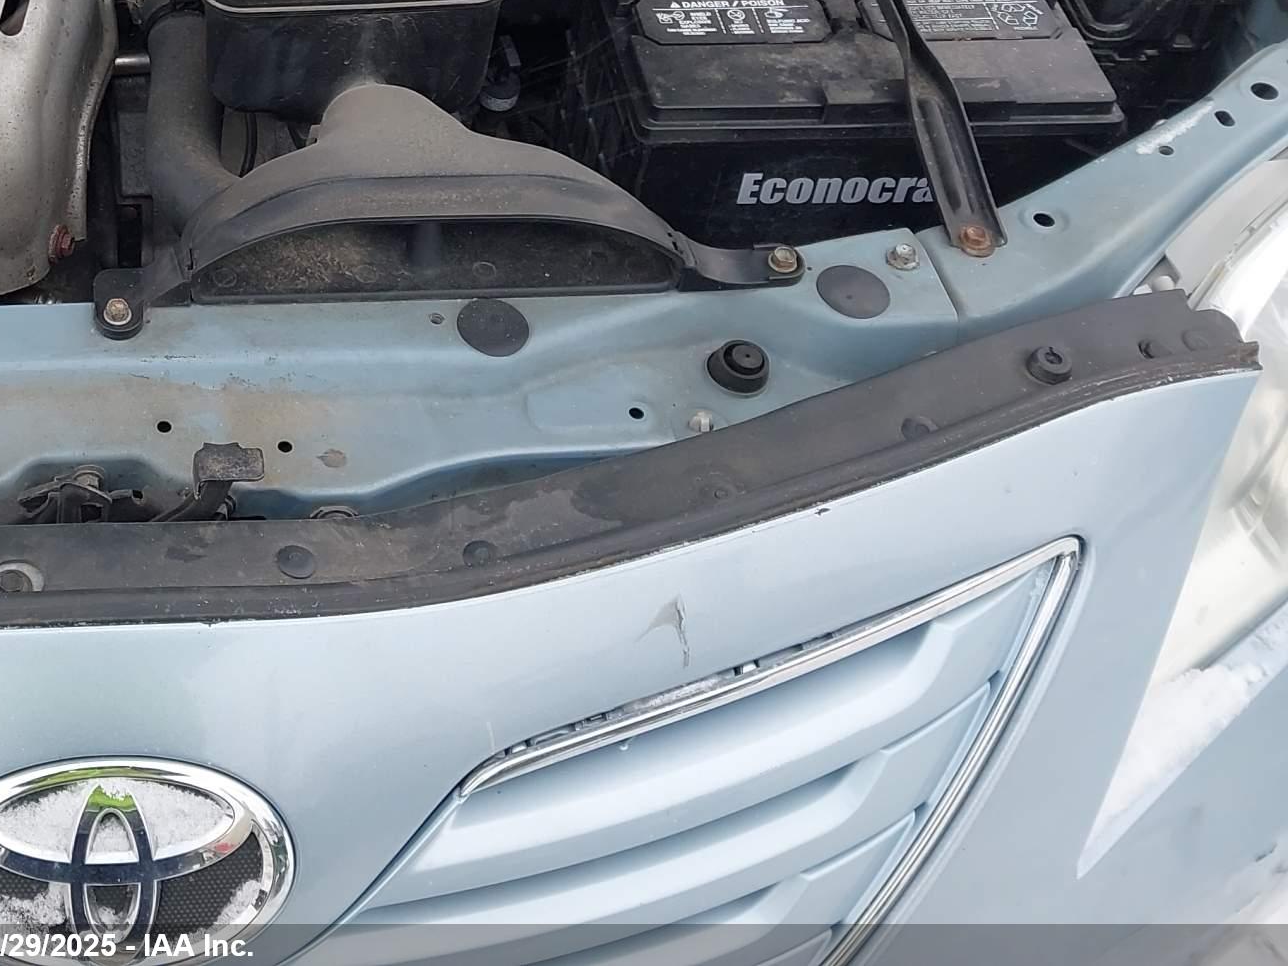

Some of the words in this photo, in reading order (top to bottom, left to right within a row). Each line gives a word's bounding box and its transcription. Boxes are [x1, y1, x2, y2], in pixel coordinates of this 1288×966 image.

[681, 0, 730, 9] DANGER
[742, 0, 785, 7] POISON
[735, 172, 934, 205] Econocra
